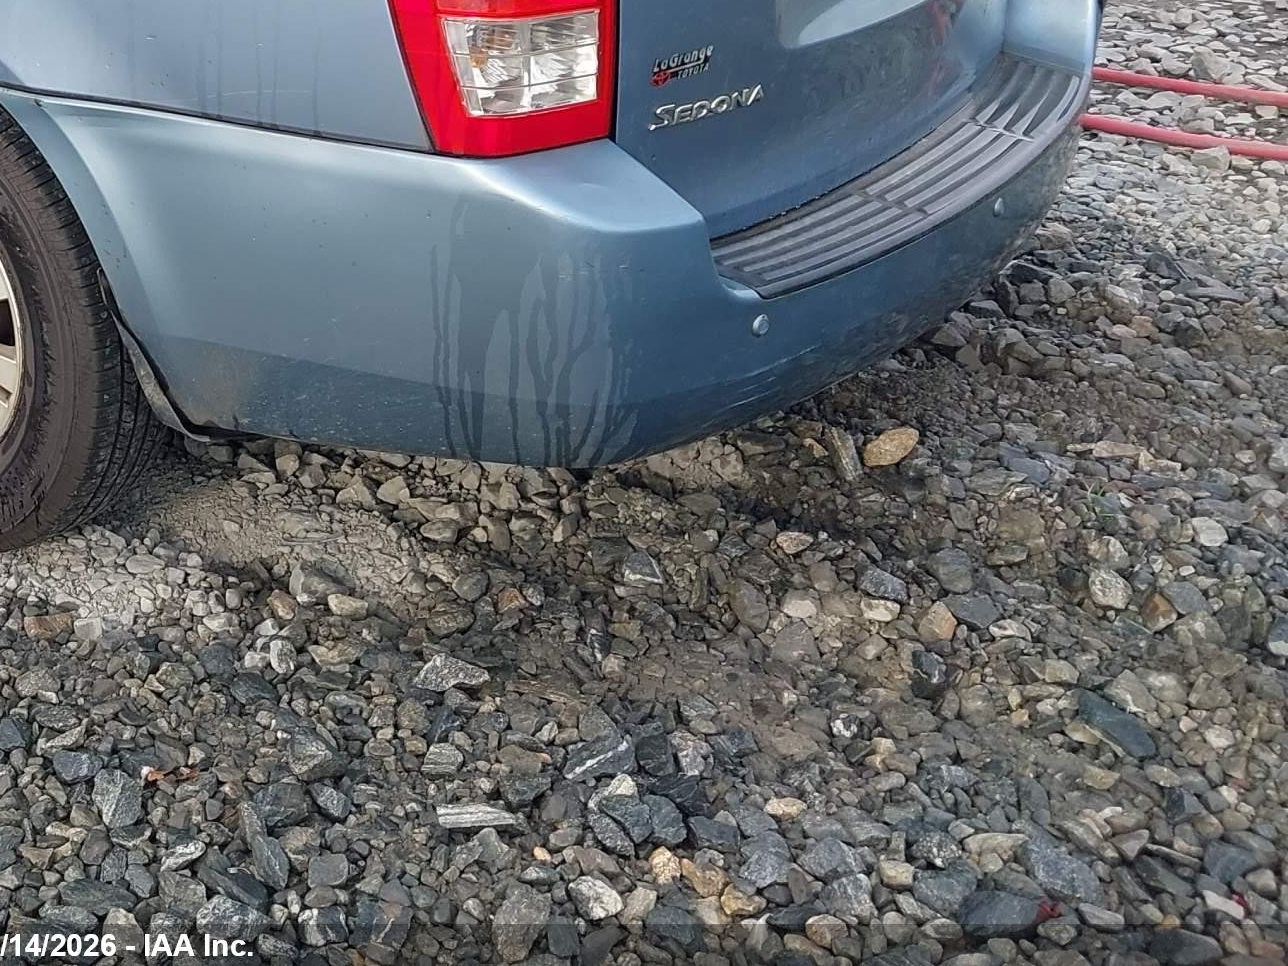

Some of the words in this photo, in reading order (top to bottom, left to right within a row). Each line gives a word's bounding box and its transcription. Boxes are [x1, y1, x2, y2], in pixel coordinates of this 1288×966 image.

[653, 45, 714, 73] LaGrange
[677, 63, 710, 80] TOYOTA
[648, 81, 765, 131] SEDONA
